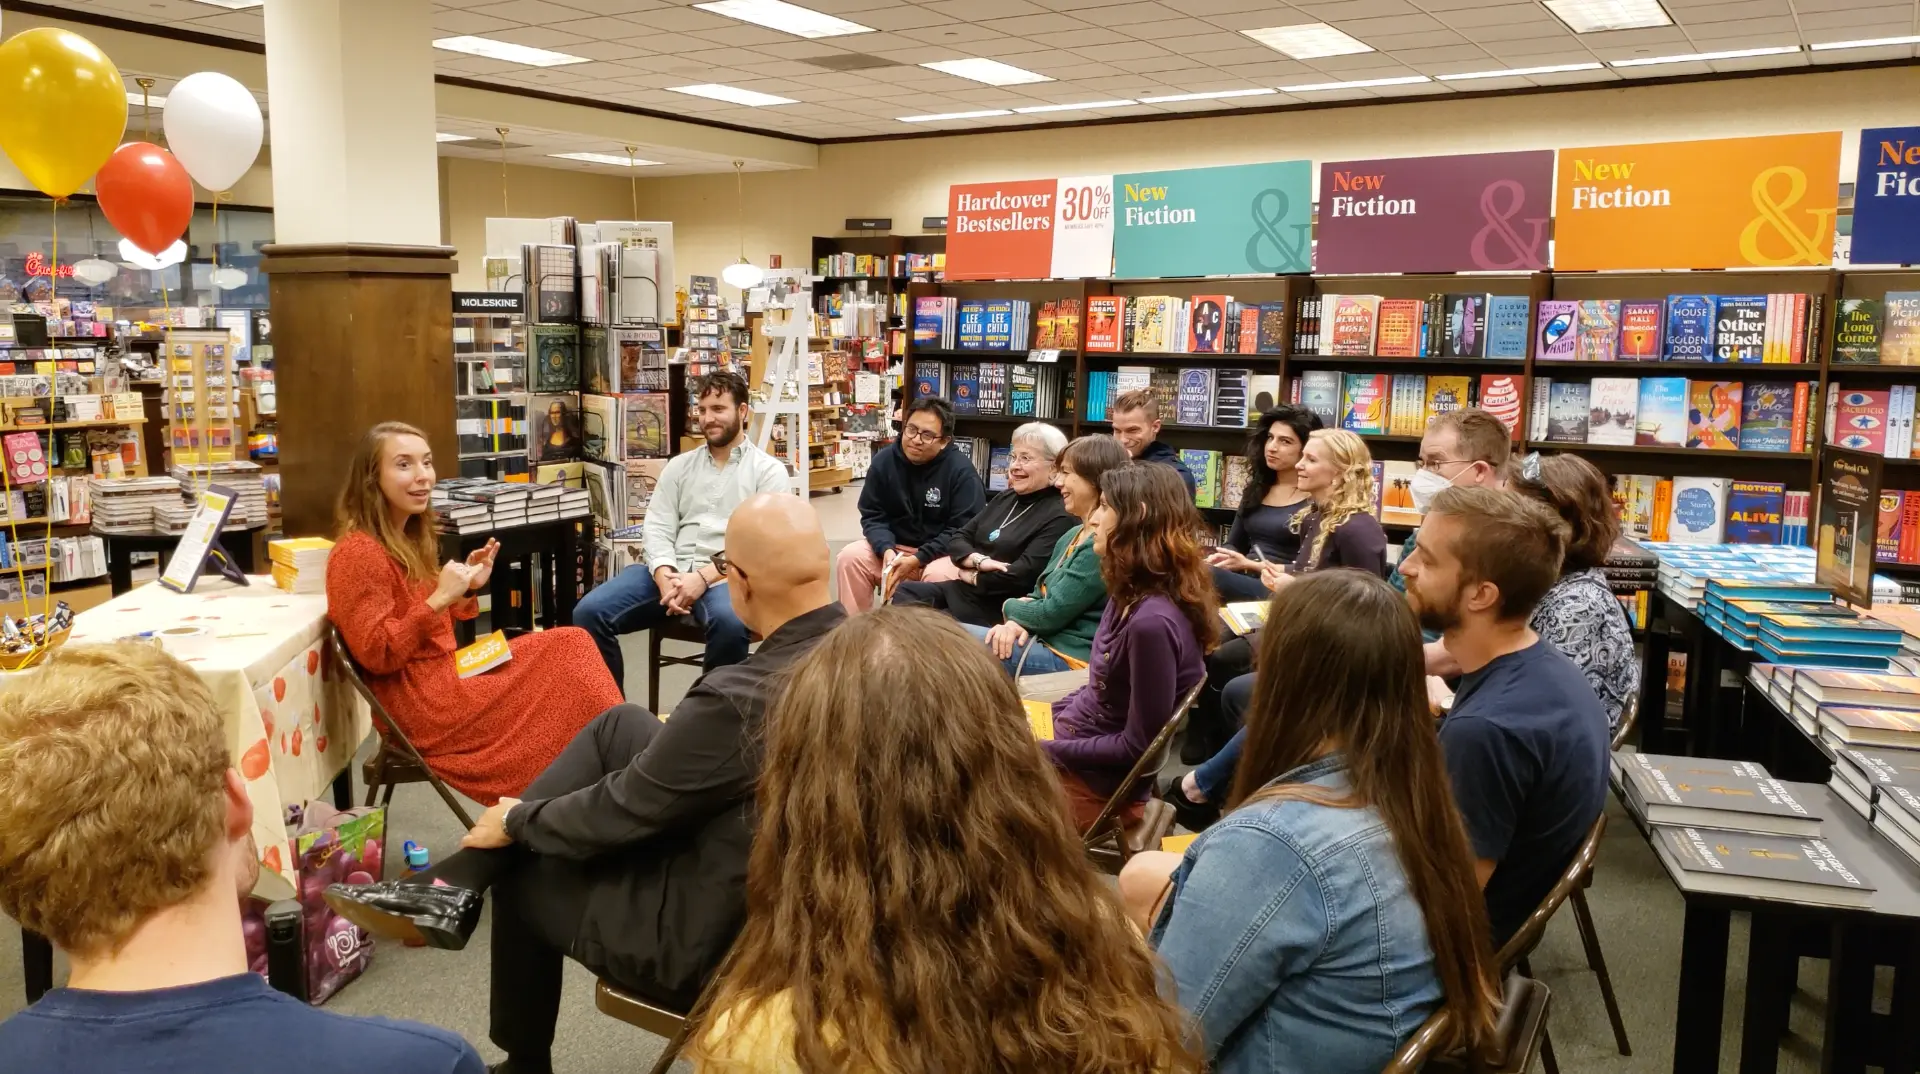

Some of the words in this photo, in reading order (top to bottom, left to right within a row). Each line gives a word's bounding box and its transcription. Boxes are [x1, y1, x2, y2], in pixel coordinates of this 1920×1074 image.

[1877, 140, 1920, 166] Ne
[1573, 159, 1636, 181] New
[1333, 171, 1385, 192] New
[1124, 183, 1168, 203] New
[1572, 185, 1671, 209] Fiction
[957, 191, 1051, 212] Hardcover
[1332, 195, 1416, 217] Fiction
[1093, 206, 1110, 219] OFF
[1124, 205, 1196, 226] Fiction
[1739, 165, 1837, 266] &
[956, 211, 1050, 233] Bestsellers
[1470, 179, 1550, 270] &
[1245, 188, 1310, 273] &
[461, 298, 518, 308] MOLESKINE
[1888, 299, 1920, 307] MERC
[1674, 309, 1708, 317] HOUSE
[1737, 309, 1760, 318] The
[1851, 311, 1870, 321] The
[966, 314, 979, 323] LEE
[992, 314, 1003, 323] LEE
[962, 324, 982, 333] CHILD
[987, 324, 1008, 333] CHILD
[1718, 319, 1766, 331] Other
[1844, 322, 1874, 334] Long
[634, 331, 658, 339] BOOKS
[1667, 336, 1708, 344] GOLDEN
[1718, 333, 1763, 345] Black
[1837, 333, 1878, 343] Corner
[1550, 341, 1575, 354] HAMID
[1673, 345, 1702, 353] DOOR
[915, 369, 939, 378] KING
[979, 369, 1005, 377] VINCE
[1012, 365, 1026, 374] JOHN
[953, 372, 977, 381] KING
[1012, 375, 1035, 385] SANDFORD
[1136, 375, 1148, 384] kay
[979, 390, 997, 399] OATH
[1562, 387, 1580, 395] THE
[1749, 384, 1791, 398] Flying
[1441, 394, 1452, 402] THE
[1486, 396, 1509, 404] Catch
[977, 400, 1005, 409] LOYALTY
[1013, 399, 1034, 415] PREY
[1751, 398, 1784, 412] Solo
[1308, 406, 1334, 416] AVEN
[1554, 413, 1584, 421] SEVEN
[1733, 483, 1782, 493] BROTHER
[1730, 511, 1780, 524] ALIVE
[1657, 780, 1683, 804] LIMBAUGH
[1693, 841, 1724, 869] LIMBAUGH
